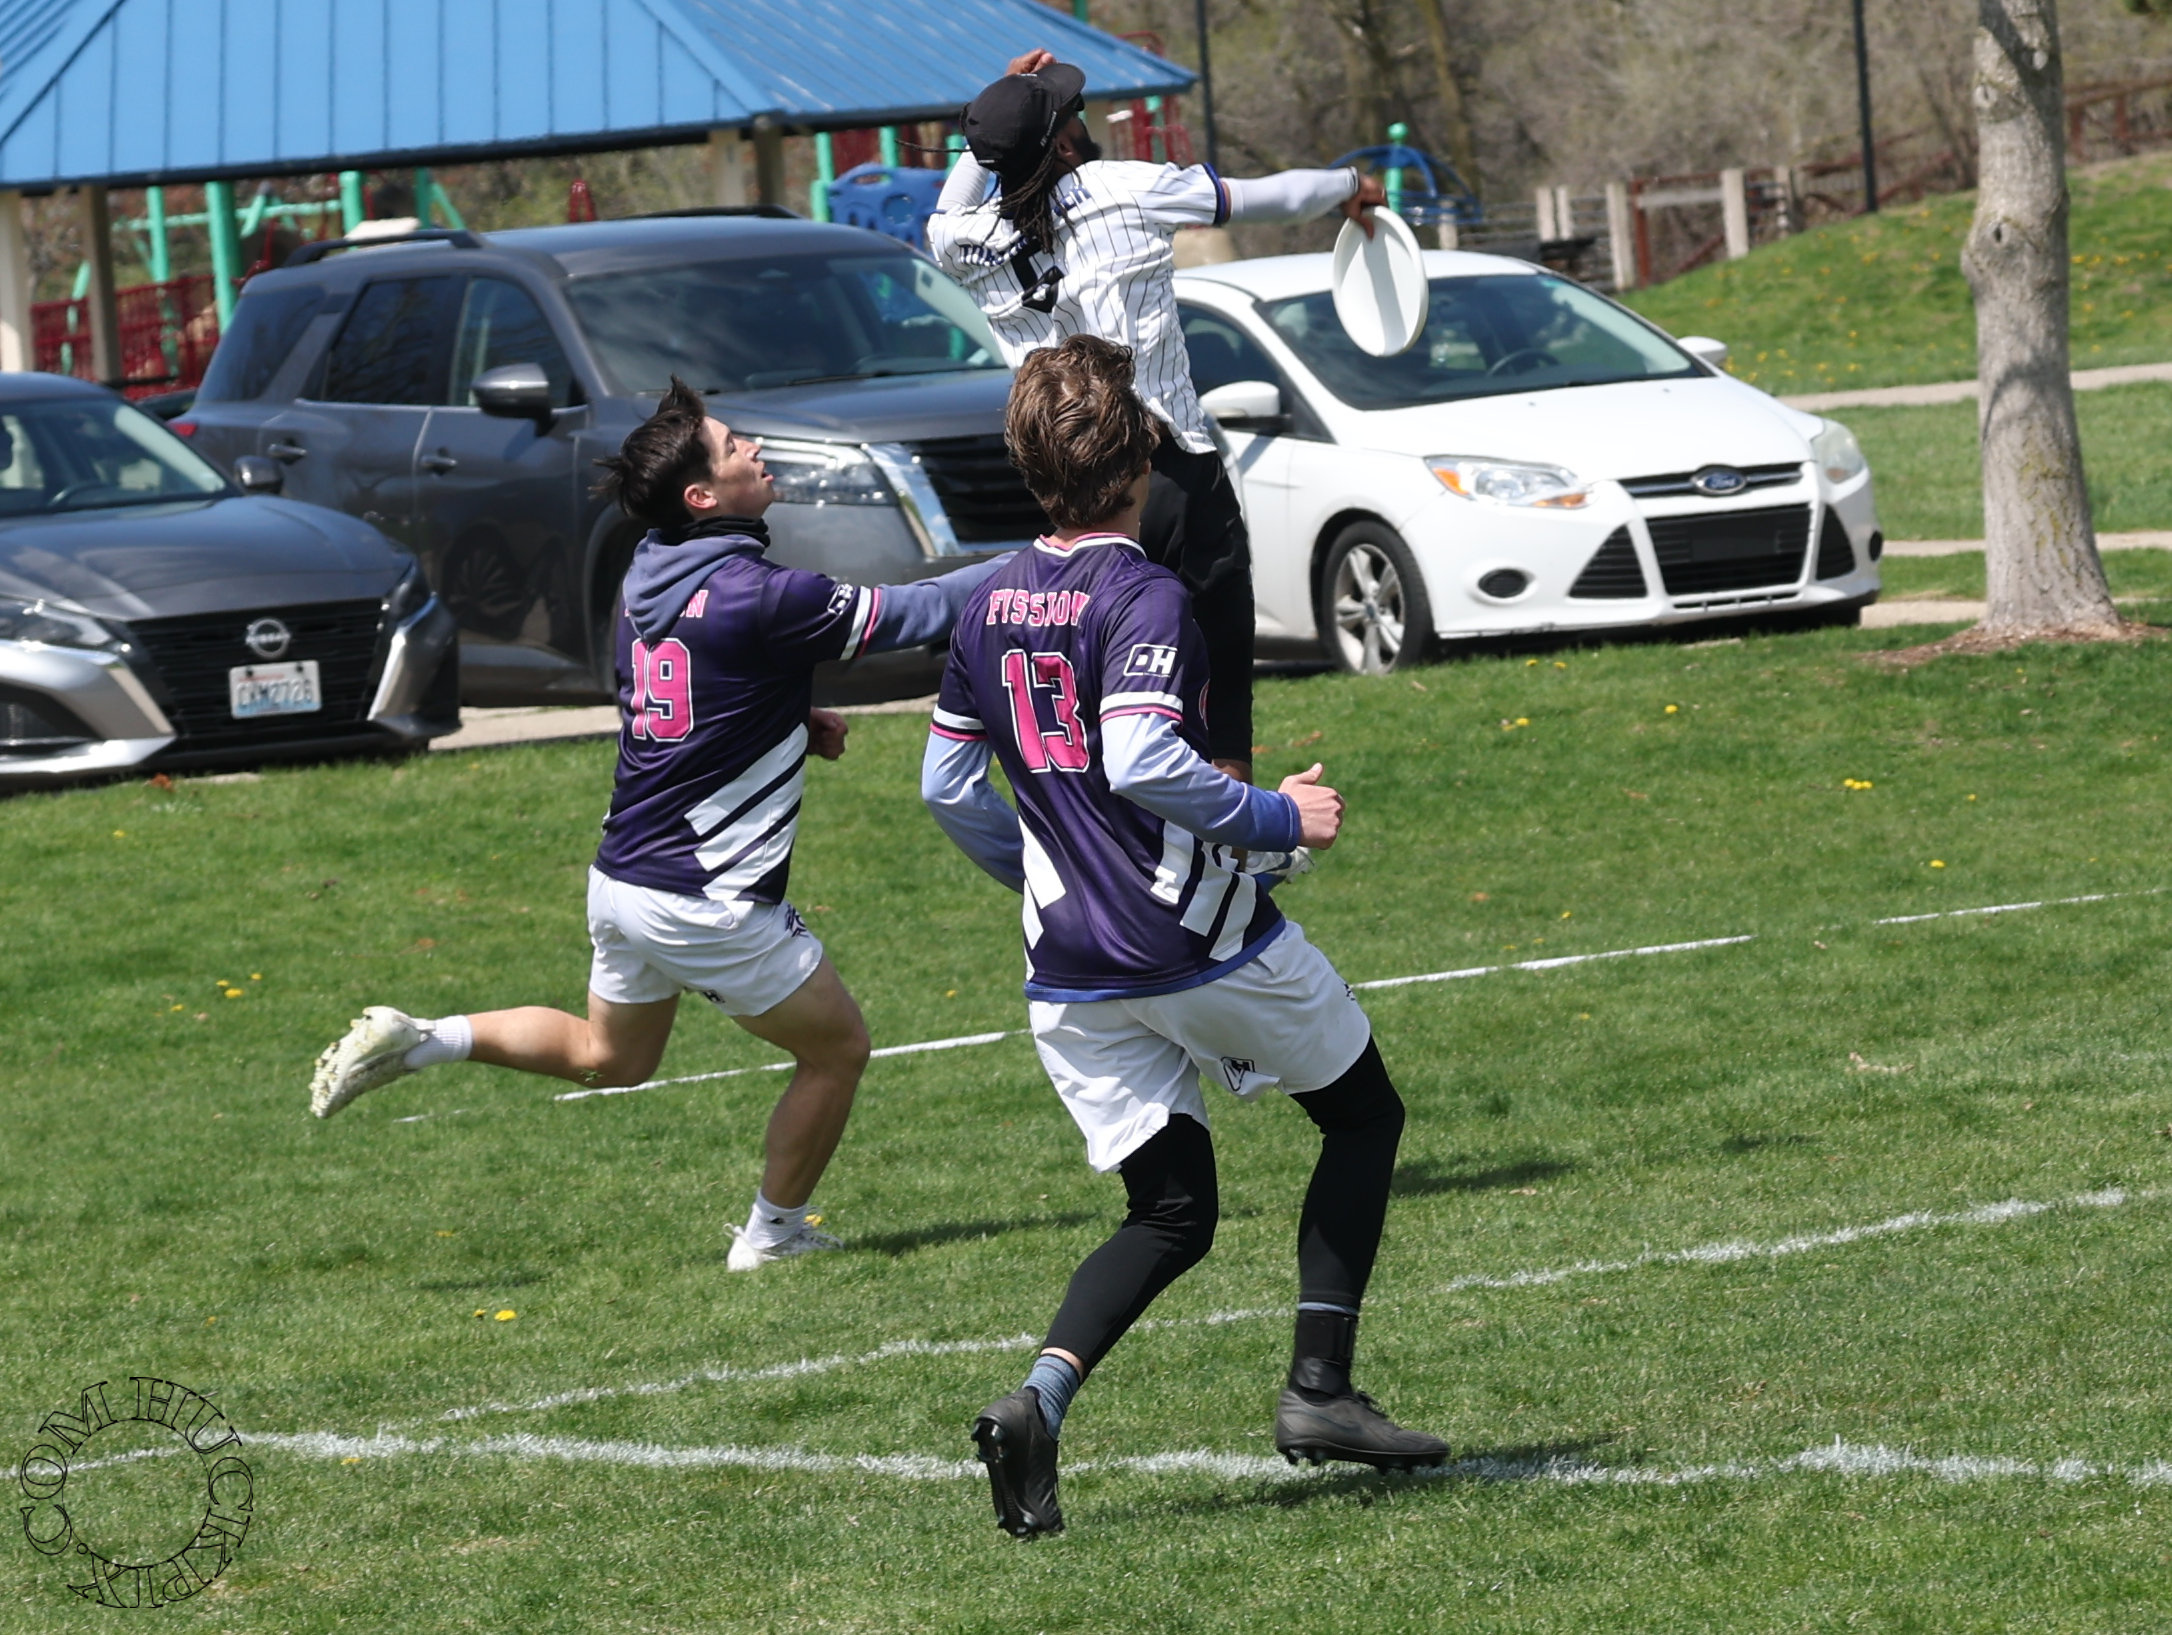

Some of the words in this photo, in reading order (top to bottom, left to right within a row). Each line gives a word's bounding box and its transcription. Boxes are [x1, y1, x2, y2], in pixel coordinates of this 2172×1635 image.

[986, 588, 1091, 627] FISSION
[630, 637, 694, 742] 19
[1001, 648, 1090, 773] 13
